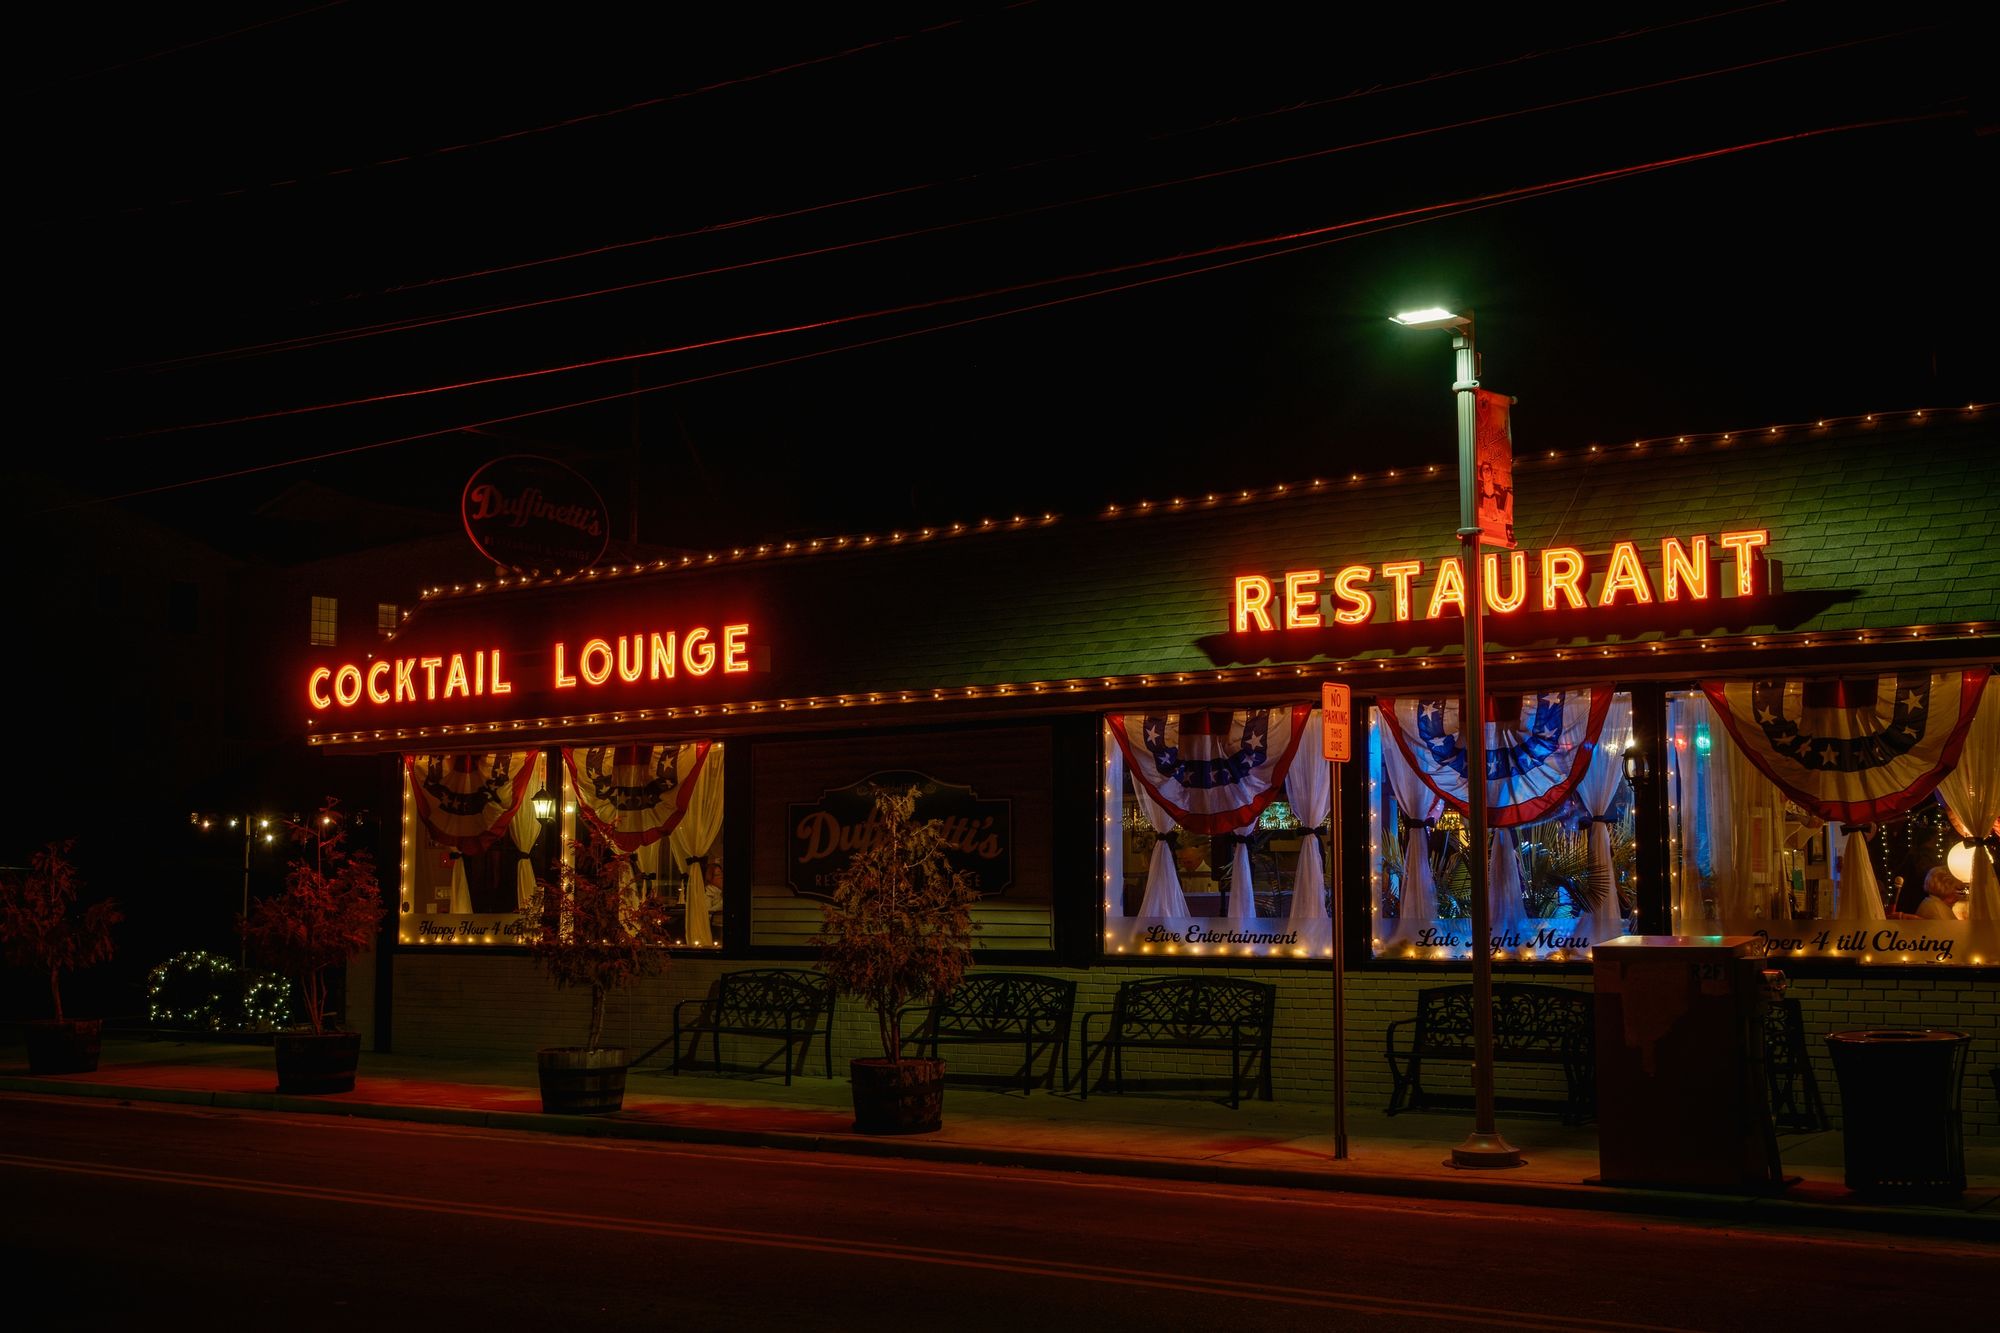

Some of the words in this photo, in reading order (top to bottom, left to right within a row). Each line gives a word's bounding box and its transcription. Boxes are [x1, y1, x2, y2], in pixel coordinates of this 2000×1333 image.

[470, 483, 602, 537] Duffinetti's
[1235, 529, 1770, 633] RESTAURANT
[308, 648, 512, 709] COCKTAIL
[555, 623, 749, 688] LOUNGE
[1330, 693, 1342, 707] NO
[1324, 709, 1347, 725] PARKING
[1331, 728, 1342, 738] THIS
[1330, 741, 1342, 751] SIDE
[419, 920, 456, 940] Happy
[458, 920, 488, 935] Hour
[491, 920, 501, 936] 4
[1145, 925, 1180, 943] Live
[1185, 924, 1298, 945] Entertainment
[1416, 927, 1460, 948] Late
[1526, 927, 1590, 949] Menu
[1810, 929, 1830, 951] 4
[1836, 930, 1868, 951] till
[1872, 929, 1954, 961] Closing
